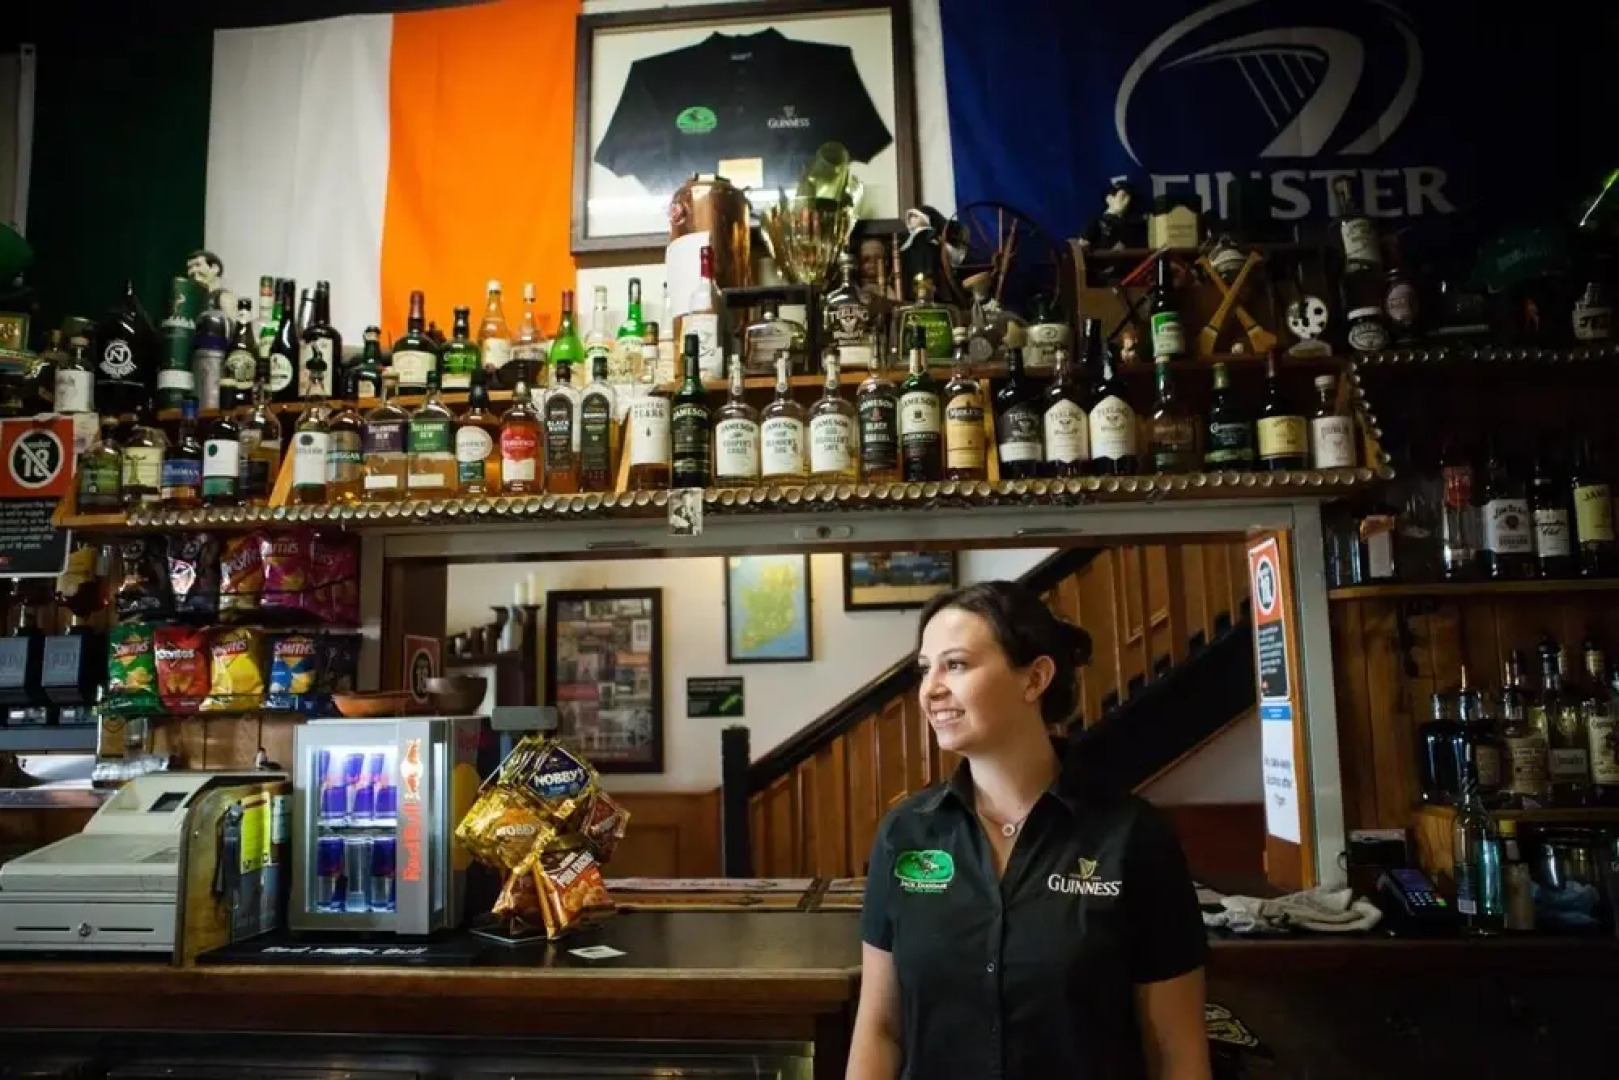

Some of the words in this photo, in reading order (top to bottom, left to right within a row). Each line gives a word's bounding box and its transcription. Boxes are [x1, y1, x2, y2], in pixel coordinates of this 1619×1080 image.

[767, 117, 810, 129] GUINNESS
[20, 448, 51, 477] 18
[402, 802, 421, 840] Bull
[402, 841, 421, 881] Red
[1047, 873, 1123, 896] GUINNESS
